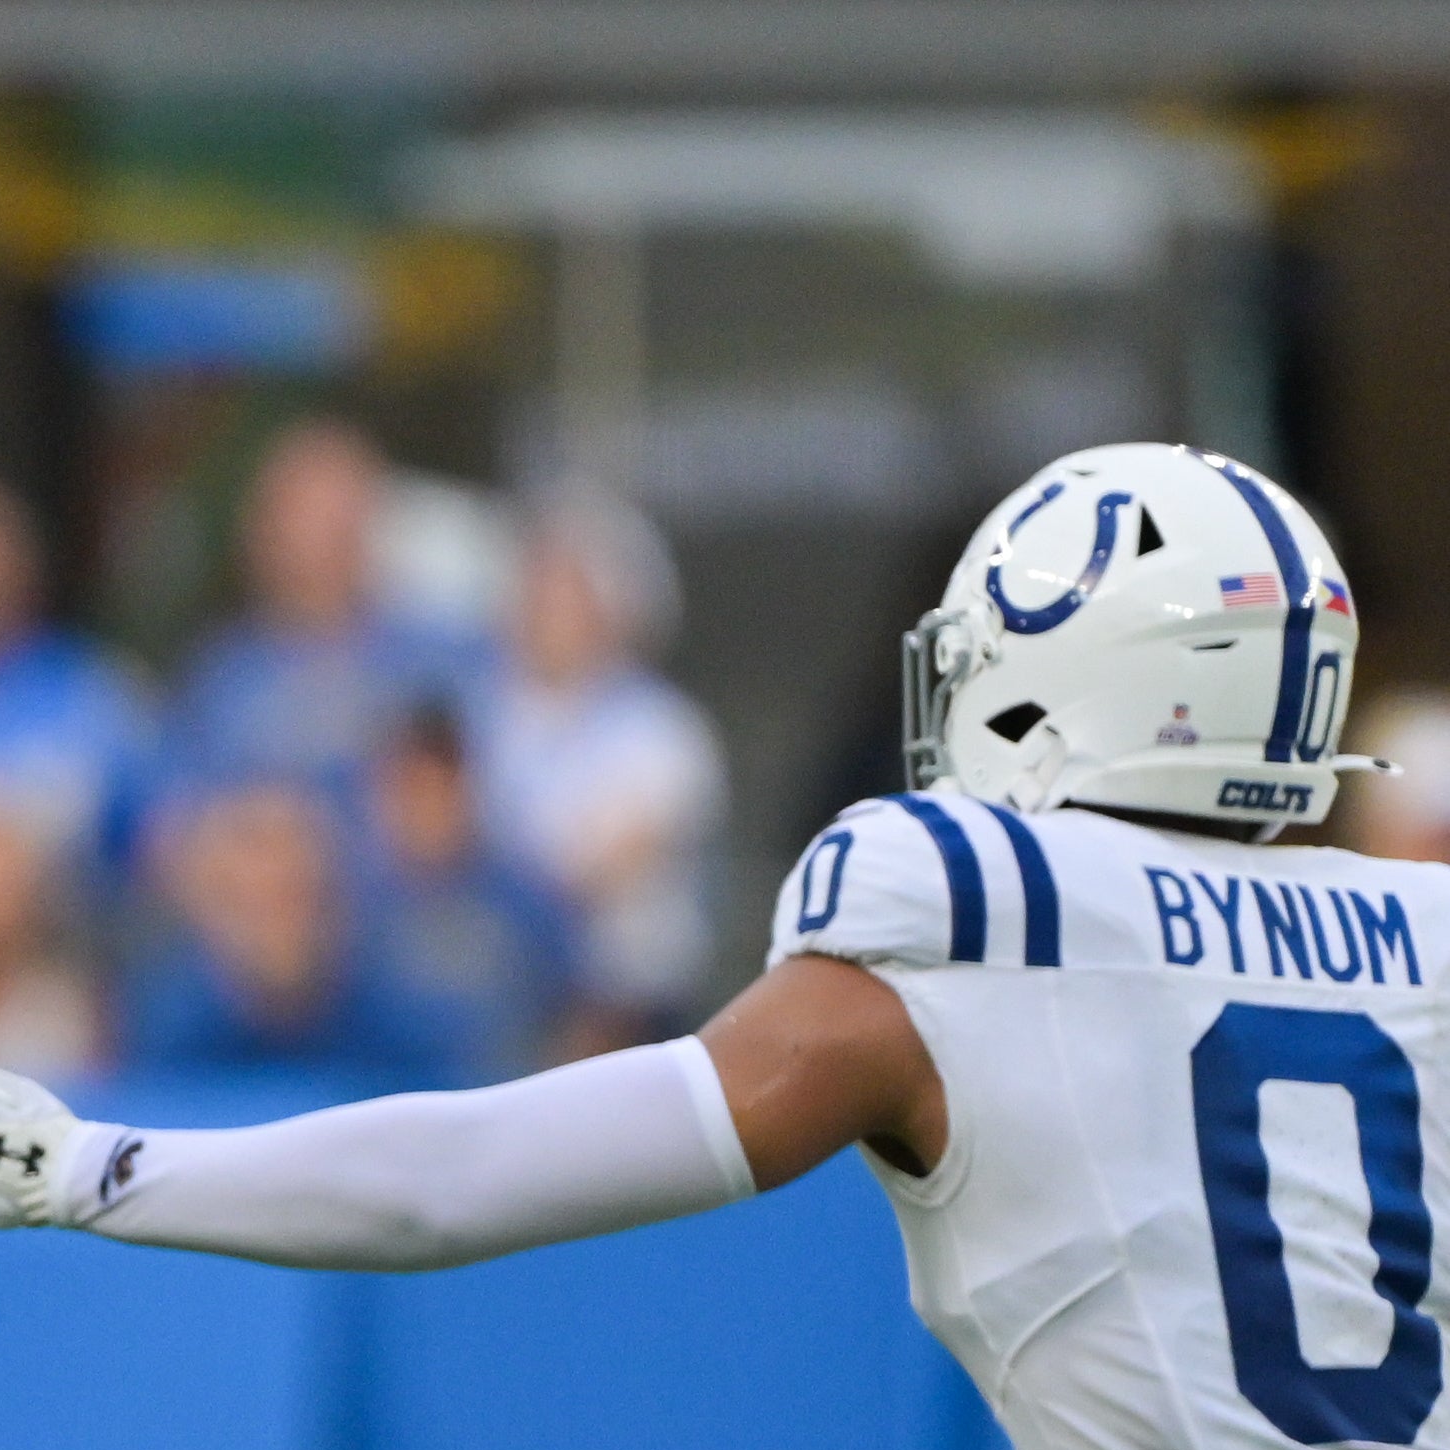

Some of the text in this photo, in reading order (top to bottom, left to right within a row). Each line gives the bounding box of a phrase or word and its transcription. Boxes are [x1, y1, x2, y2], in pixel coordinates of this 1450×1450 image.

[1297, 651, 1341, 762] 0
[1217, 779, 1314, 812] COLTS
[799, 830, 854, 934] 0
[1143, 865, 1422, 986] BYNUM
[1189, 1001, 1443, 1445] 0
